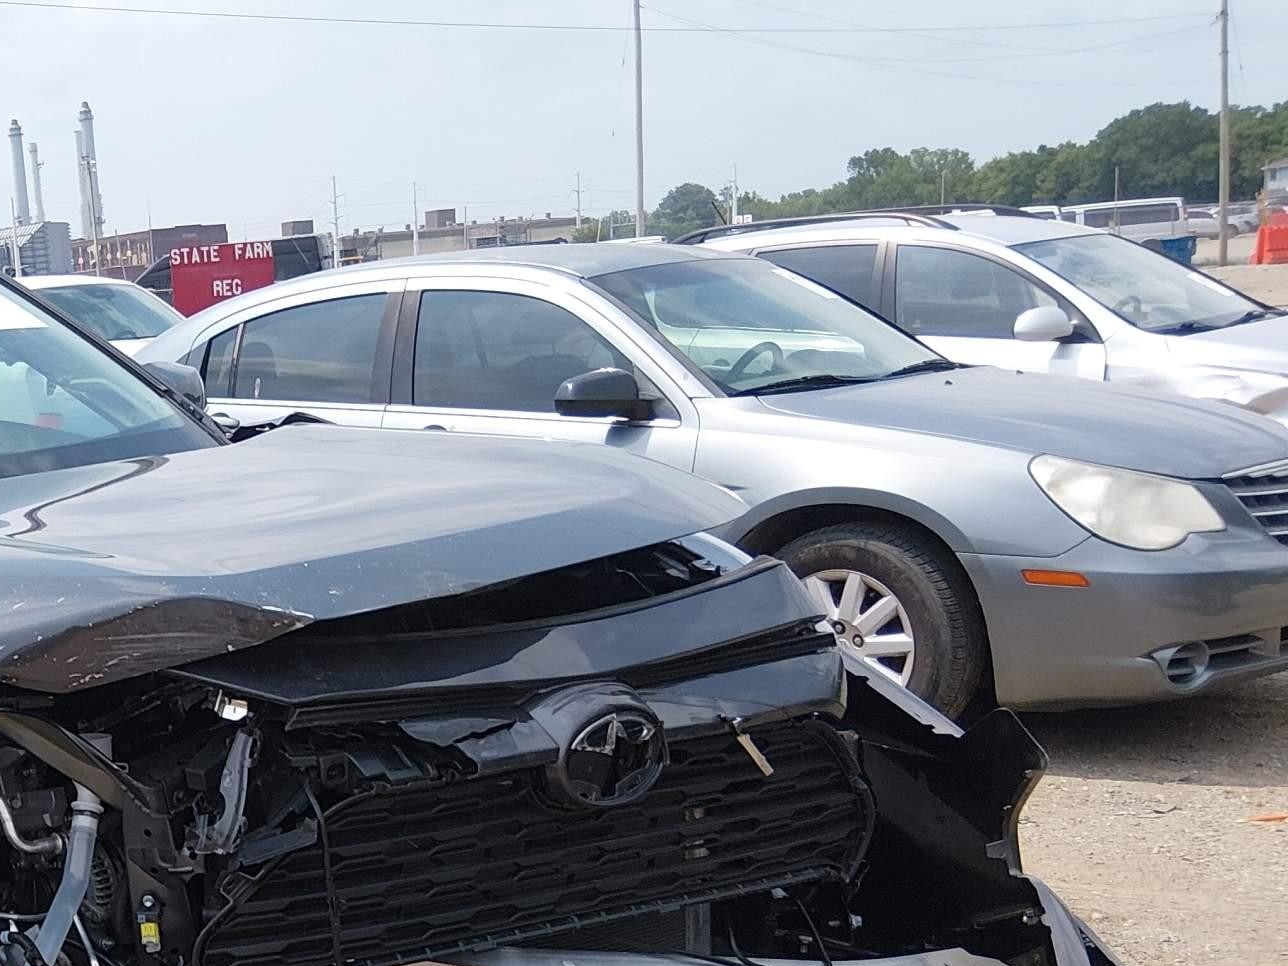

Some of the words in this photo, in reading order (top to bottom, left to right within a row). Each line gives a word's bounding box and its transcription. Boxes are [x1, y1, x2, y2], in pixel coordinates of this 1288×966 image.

[171, 245, 220, 265] STATE
[235, 241, 274, 260] FARM
[213, 279, 243, 297] REG
